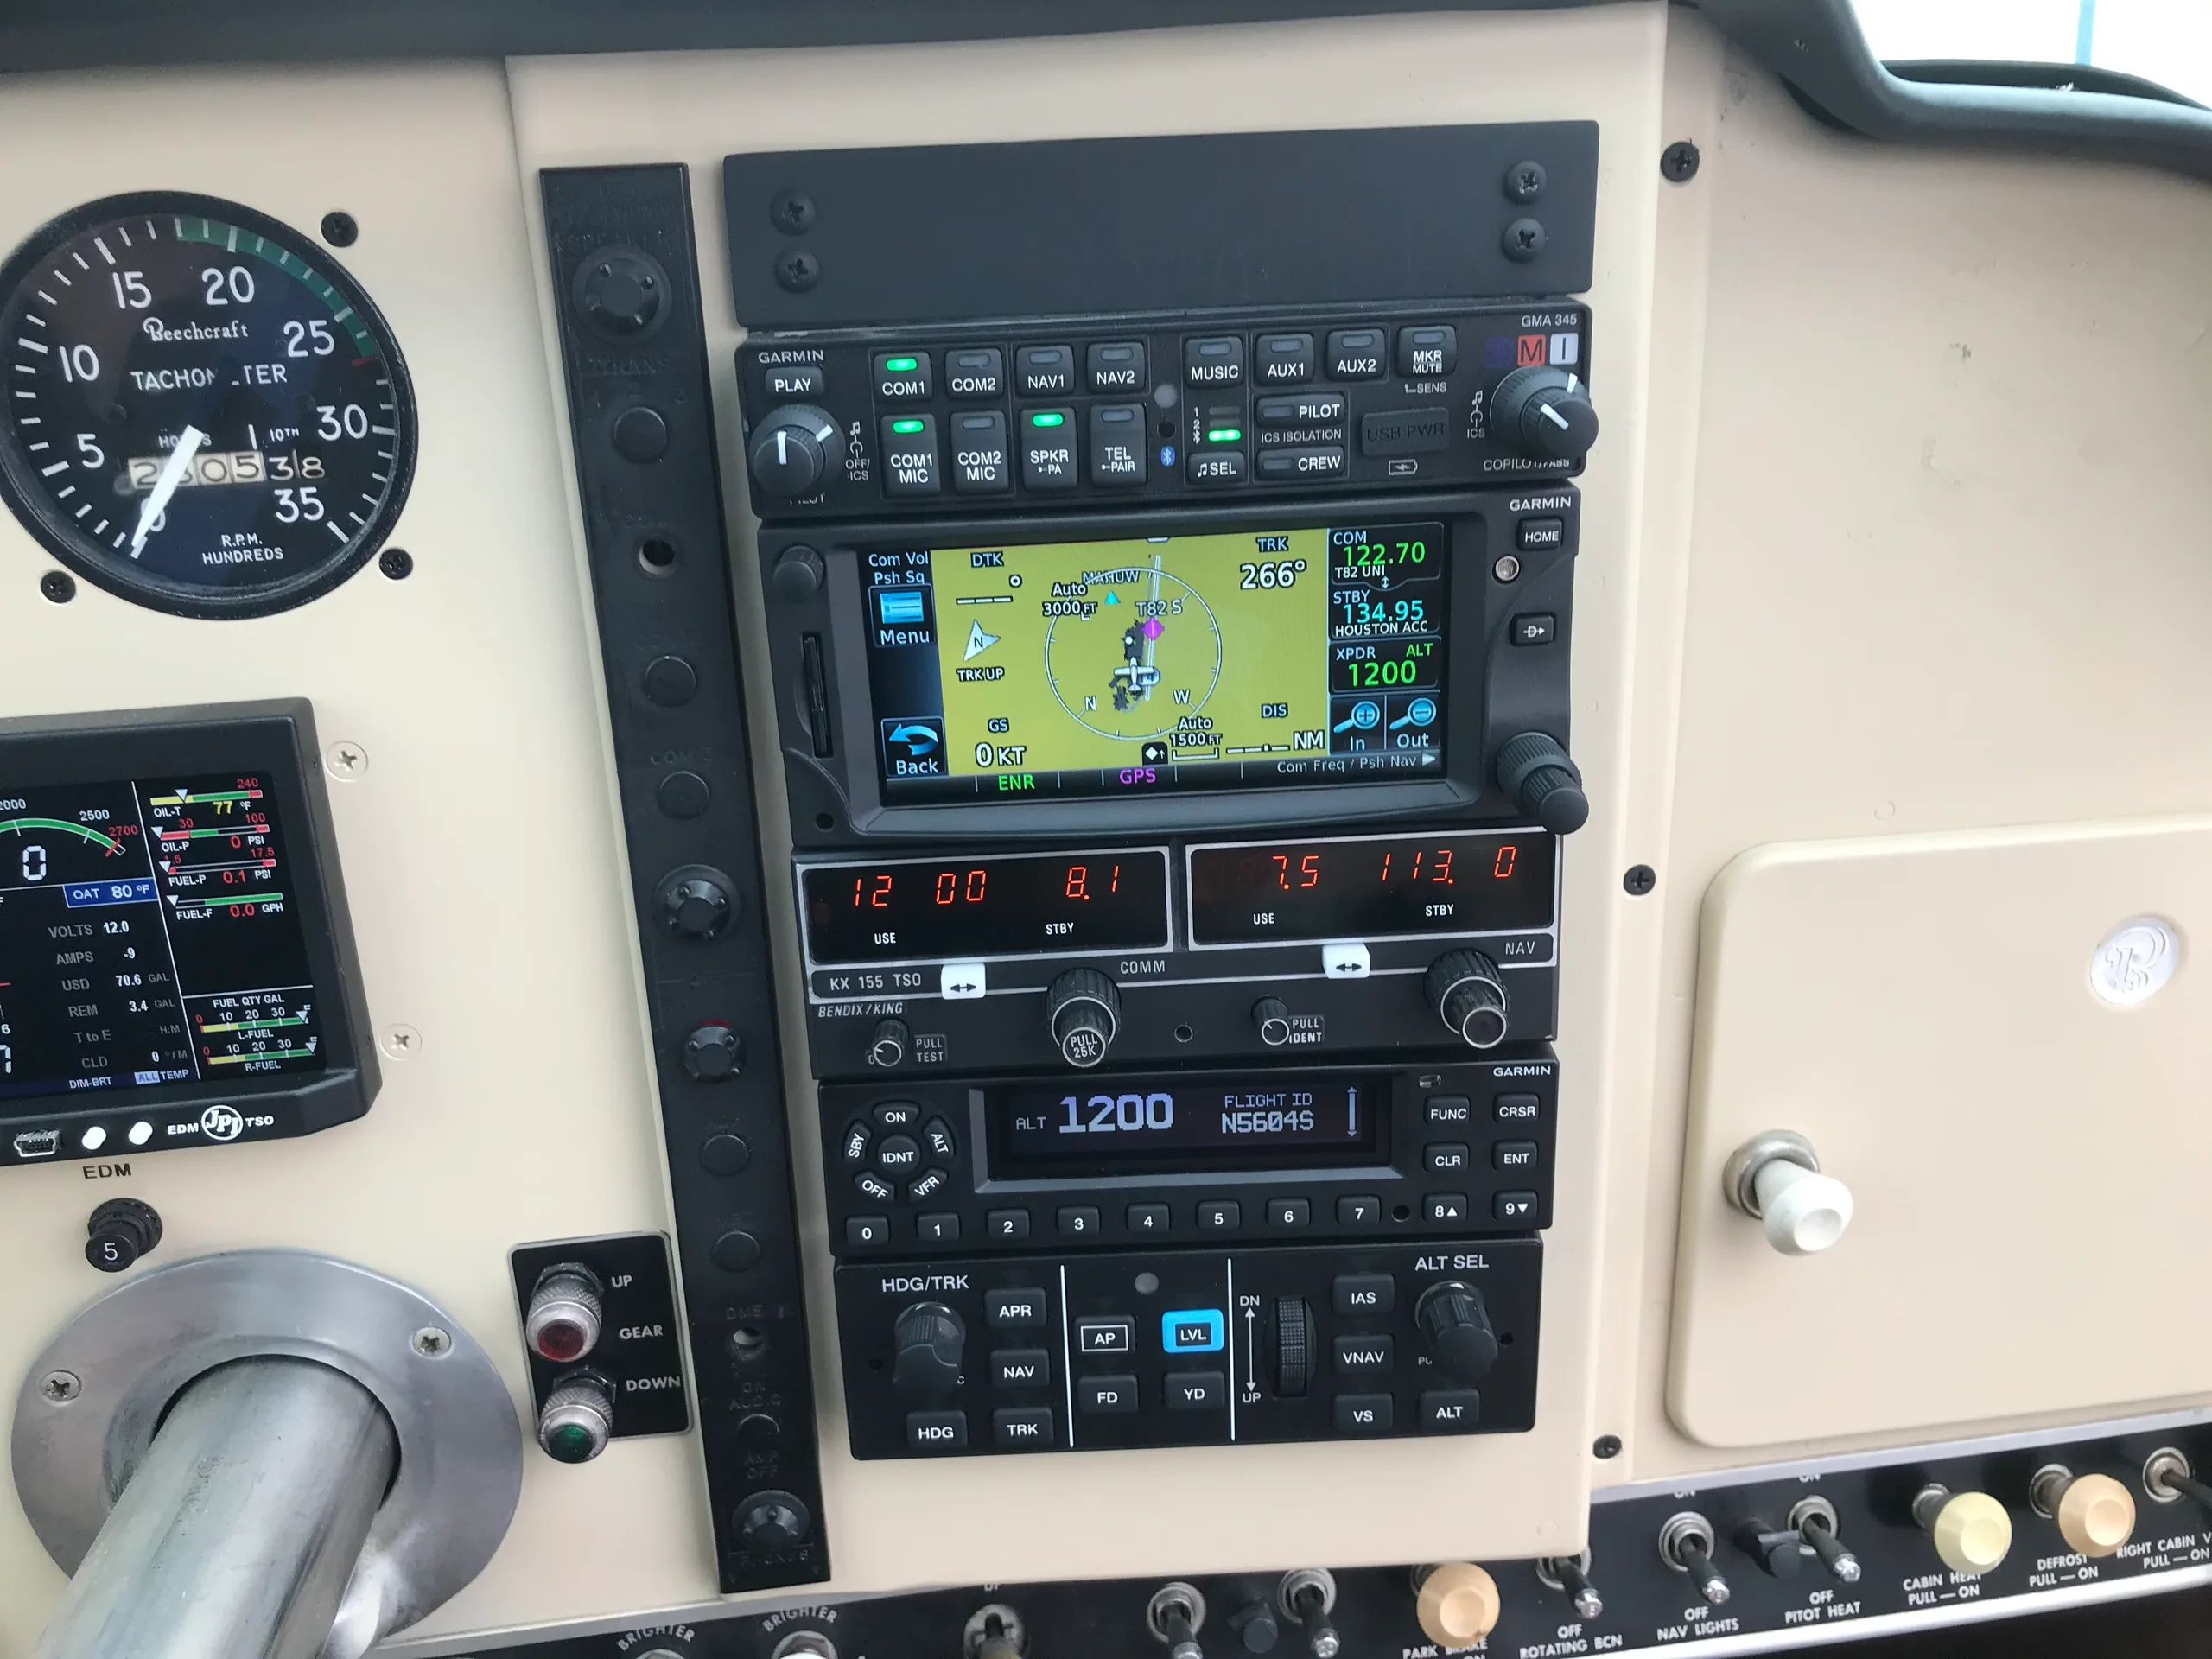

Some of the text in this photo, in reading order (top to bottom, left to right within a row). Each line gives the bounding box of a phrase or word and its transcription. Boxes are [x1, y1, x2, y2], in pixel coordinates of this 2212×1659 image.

[112, 271, 152, 309] 15
[201, 266, 255, 306] 20
[1522, 314, 1577, 327] GMA 345
[143, 317, 249, 343] Beechcraft
[283, 320, 335, 358] 25
[59, 344, 99, 383] 10
[758, 349, 824, 364] GARMIN
[1413, 349, 1443, 363] MKR
[1191, 365, 1239, 380] MUSIC
[1268, 363, 1304, 378] AUX1
[1337, 357, 1376, 373] AUX2
[1413, 362, 1443, 374] MUTE
[774, 378, 811, 393] PLAY
[952, 378, 996, 391] COM2
[1028, 374, 1065, 389] NAV1
[1096, 371, 1135, 385] NAV2
[882, 381, 925, 396] COM1
[1299, 404, 1340, 419] PILOT
[316, 404, 369, 441] 30
[1262, 429, 1342, 443] ICS ISOLATION
[891, 454, 932, 468] COM1
[957, 450, 1001, 466] COM2
[1030, 448, 1069, 464] SPKR
[1105, 447, 1131, 461] TEL
[1298, 455, 1340, 471] CREW
[899, 468, 929, 484] MIC
[966, 467, 995, 481] MIC
[275, 486, 326, 523] 35
[1510, 496, 1572, 512] GARMIN
[1257, 537, 1287, 551] TRK
[1333, 531, 1367, 545] COM
[1524, 531, 1559, 543] HOME
[202, 548, 284, 566] HUNDREDS
[868, 551, 929, 567] Com Vol
[972, 553, 1003, 567] DTK
[1344, 542, 1425, 567] 122.70
[874, 571, 900, 585] Psh
[1335, 567, 1358, 579] T82
[1052, 583, 1087, 596] Auto
[1333, 589, 1370, 604] STBY
[1344, 600, 1424, 624] 134.95
[1335, 620, 1427, 637] HOUSTON ACC
[880, 630, 930, 645] Menu
[1336, 643, 1433, 661] XPDR ALT
[957, 668, 1004, 682] TRK UP
[1349, 660, 1416, 687] 1200
[1262, 704, 1287, 718] DIS
[988, 720, 1008, 732] GS
[1179, 717, 1212, 731] Auto
[1294, 731, 1325, 751] NM
[1396, 733, 1429, 748] Out
[997, 747, 1025, 766] KT
[1277, 755, 1416, 773] Com Freq Psh Nav
[896, 759, 938, 775] Back
[238, 779, 258, 789] 240
[998, 767, 1157, 791] ENR GPS
[79, 810, 110, 821] 2500
[154, 802, 232, 817] OIL-T 77
[245, 813, 266, 823] 100
[109, 825, 138, 837] 2700
[162, 836, 264, 852] OIL-P PSI
[168, 870, 271, 887] FUEL-P PSI
[73, 885, 132, 899] OAT 80
[176, 903, 283, 920] FUEL-F 0.0 GPH
[1426, 904, 1454, 917] STBY
[1253, 912, 1274, 925] USE
[48, 920, 130, 938] VOLTS 12.0
[1046, 923, 1074, 936] STBY
[874, 931, 896, 944] USE
[1505, 941, 1535, 956] NAV
[56, 951, 94, 965] AMPS
[1120, 960, 1166, 975] COMM
[62, 974, 142, 991] USD 70.6
[830, 973, 921, 991] KX 155 TSO
[213, 994, 284, 1008] FUEL QTY GAL
[68, 1004, 99, 1017] REM
[818, 1002, 904, 1017] BENDIX/KING
[1292, 1019, 1319, 1030] PULL
[238, 1029, 274, 1040] L-FUEL
[916, 1038, 944, 1049] PULL
[81, 1057, 108, 1069] CLD
[916, 1051, 944, 1063] TEST
[245, 1061, 281, 1072] R-FUEL
[1493, 1065, 1551, 1077] GARMIN
[1224, 1094, 1287, 1109] FLIGHT
[885, 1112, 906, 1122] ON
[1058, 1093, 1173, 1134] 1200
[1430, 1108, 1467, 1120] FUNC
[1499, 1106, 1536, 1118] CRSR
[167, 1116, 275, 1135] EDM TSO
[1221, 1109, 1314, 1134] N5604S
[849, 1133, 864, 1158] SBY
[882, 1151, 914, 1163] IDNT
[1434, 1155, 1460, 1166] CLR
[1503, 1154, 1529, 1164] ENT
[82, 1163, 132, 1179] EDM
[914, 1176, 939, 1196] VFR
[1414, 1255, 1490, 1271] ALT SEL
[611, 1274, 632, 1288] UP
[882, 1275, 969, 1293] HDG/TRK
[1239, 1295, 1260, 1306] DN
[1351, 1292, 1376, 1305] IAS
[999, 1305, 1032, 1318] APR
[619, 1325, 664, 1340] GEAR
[1094, 1333, 1116, 1345] AP
[1180, 1329, 1206, 1341] LVL
[1343, 1351, 1384, 1364] VNAV
[1004, 1366, 1034, 1378] NAV
[626, 1376, 681, 1391] DOWN
[1097, 1392, 1118, 1404] FD
[1184, 1389, 1205, 1400] YD
[1353, 1410, 1374, 1423] VS
[1436, 1406, 1463, 1419] ALT
[918, 1427, 954, 1440] HDG
[1007, 1424, 1039, 1436] TRK
[2158, 1535, 2196, 1552] CABIN
[1903, 1573, 1943, 1592] CABIN
[1809, 1590, 1834, 1604] OFF
[1685, 1606, 1709, 1621] OFF
[1785, 1602, 1861, 1624] PITOT HEAT
[1557, 1624, 1583, 1639] OFF
[1657, 1618, 1739, 1641] NAV LIGHTS
[1519, 1635, 1623, 1659] ROTATING BCN
